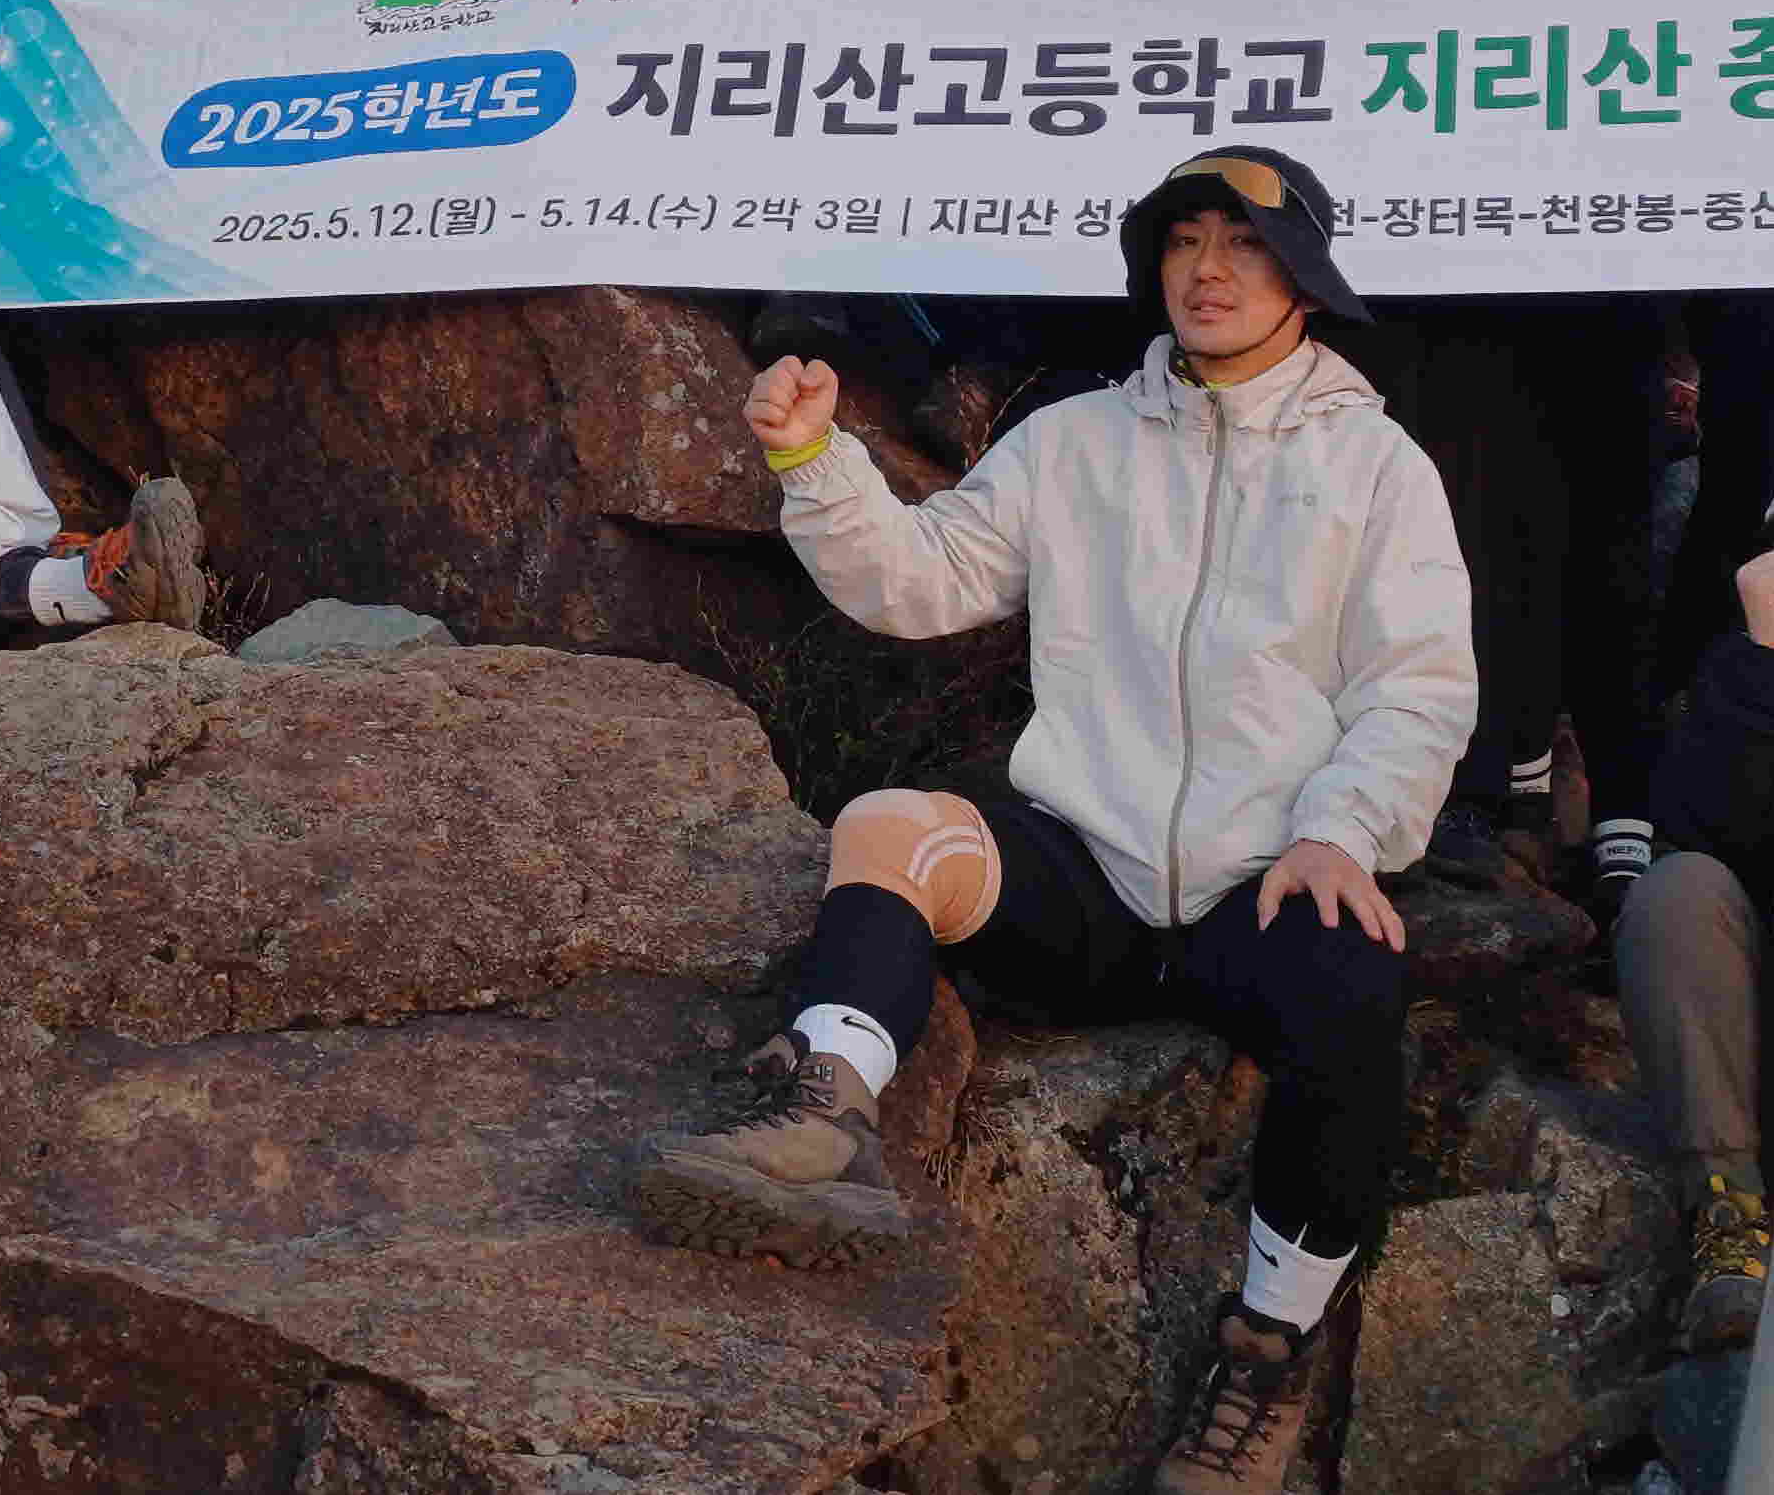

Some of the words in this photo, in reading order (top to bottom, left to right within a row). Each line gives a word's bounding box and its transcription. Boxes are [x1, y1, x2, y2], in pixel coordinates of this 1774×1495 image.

[364, 9, 496, 38] 지리산고등학교
[188, 67, 542, 155] 2025학년도
[607, 37, 1333, 138] 지리산고등학교
[1361, 19, 1692, 135] 지리산
[213, 197, 496, 243] 2025.5.12.(월)
[540, 194, 717, 233] 5.14.(수)
[732, 197, 802, 233] 2박
[815, 197, 882, 235] 3일
[930, 198, 1060, 237] 지리산
